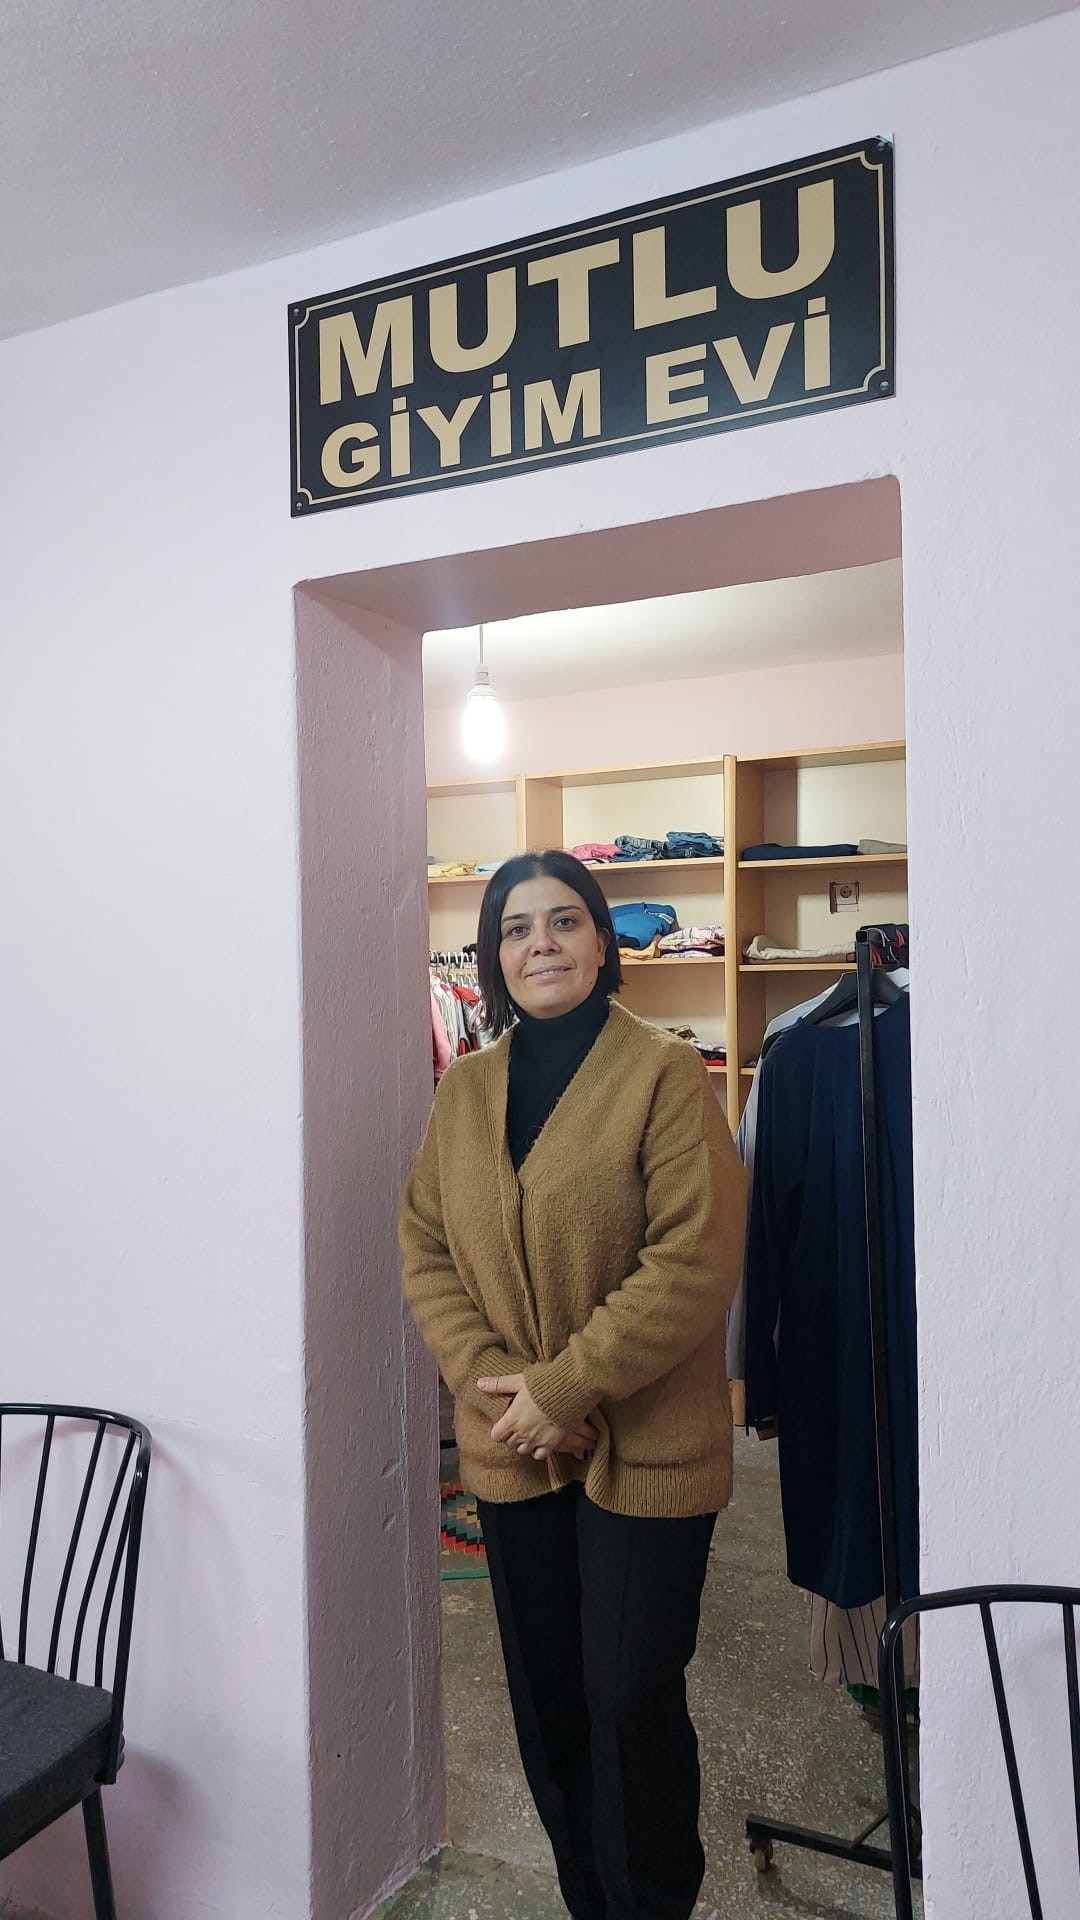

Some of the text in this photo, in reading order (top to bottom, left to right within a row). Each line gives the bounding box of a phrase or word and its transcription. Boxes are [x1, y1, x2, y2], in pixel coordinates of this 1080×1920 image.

[318, 178, 835, 406] MUTLU
[320, 296, 831, 488] GİYİM EVİ
